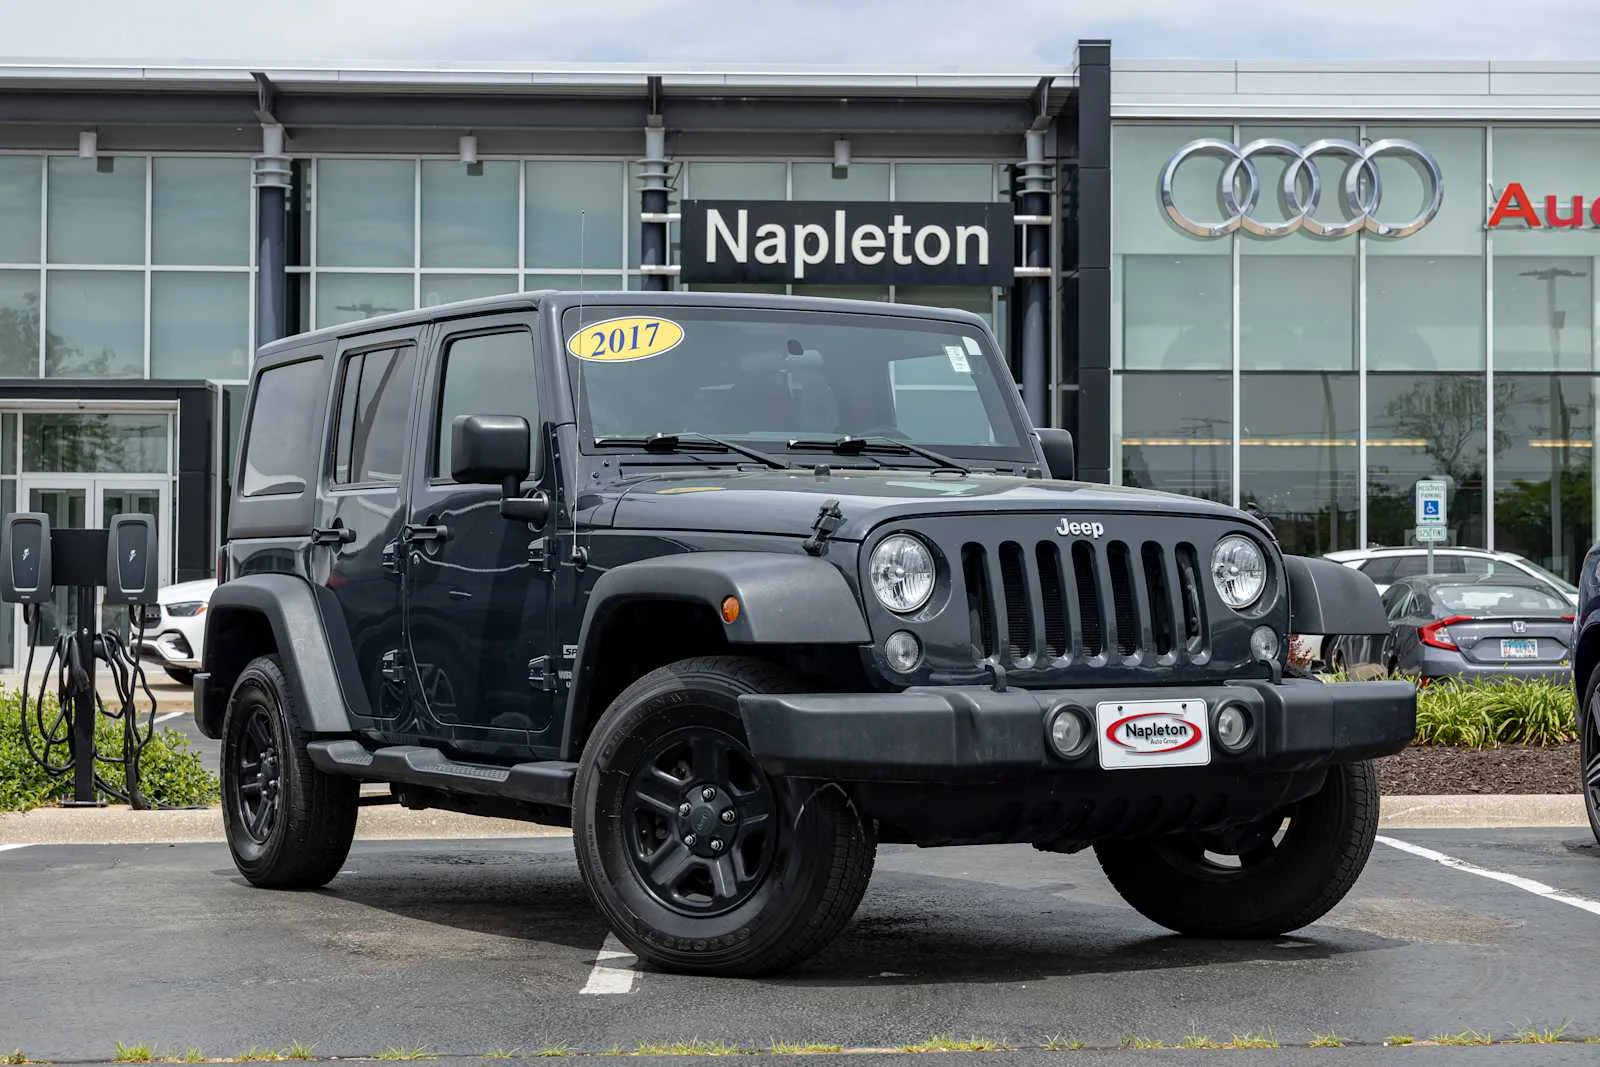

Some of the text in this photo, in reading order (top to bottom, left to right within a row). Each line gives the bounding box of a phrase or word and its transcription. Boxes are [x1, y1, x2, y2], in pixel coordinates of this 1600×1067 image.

[1487, 182, 1600, 228] Au
[706, 208, 989, 279] Napleton
[590, 322, 660, 357] 2017
[1056, 517, 1104, 540] Jeep
[1125, 722, 1188, 740] Napleton
